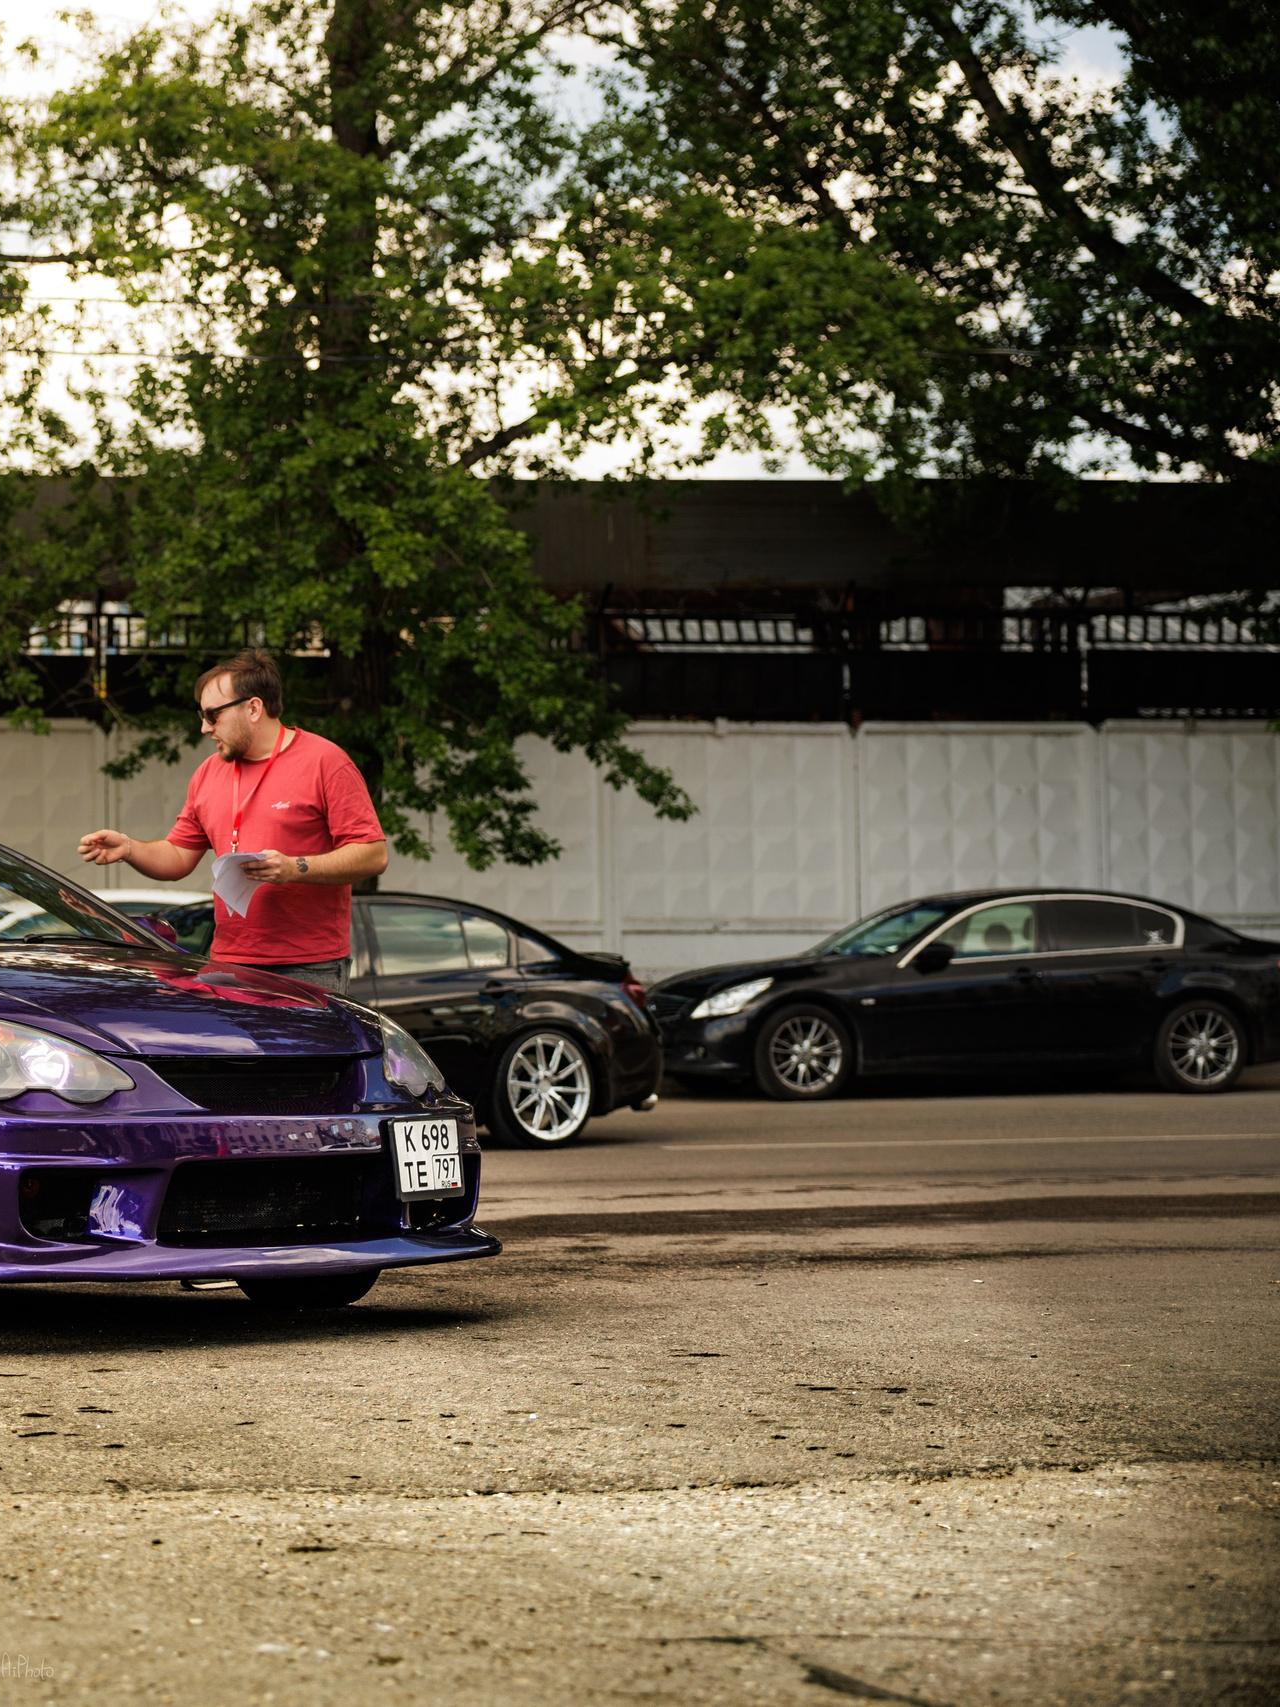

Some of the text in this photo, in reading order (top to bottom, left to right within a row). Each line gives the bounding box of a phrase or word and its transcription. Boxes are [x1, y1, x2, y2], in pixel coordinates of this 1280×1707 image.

[404, 1124, 449, 1152] K 698
[404, 1158, 455, 1188] TE 797
